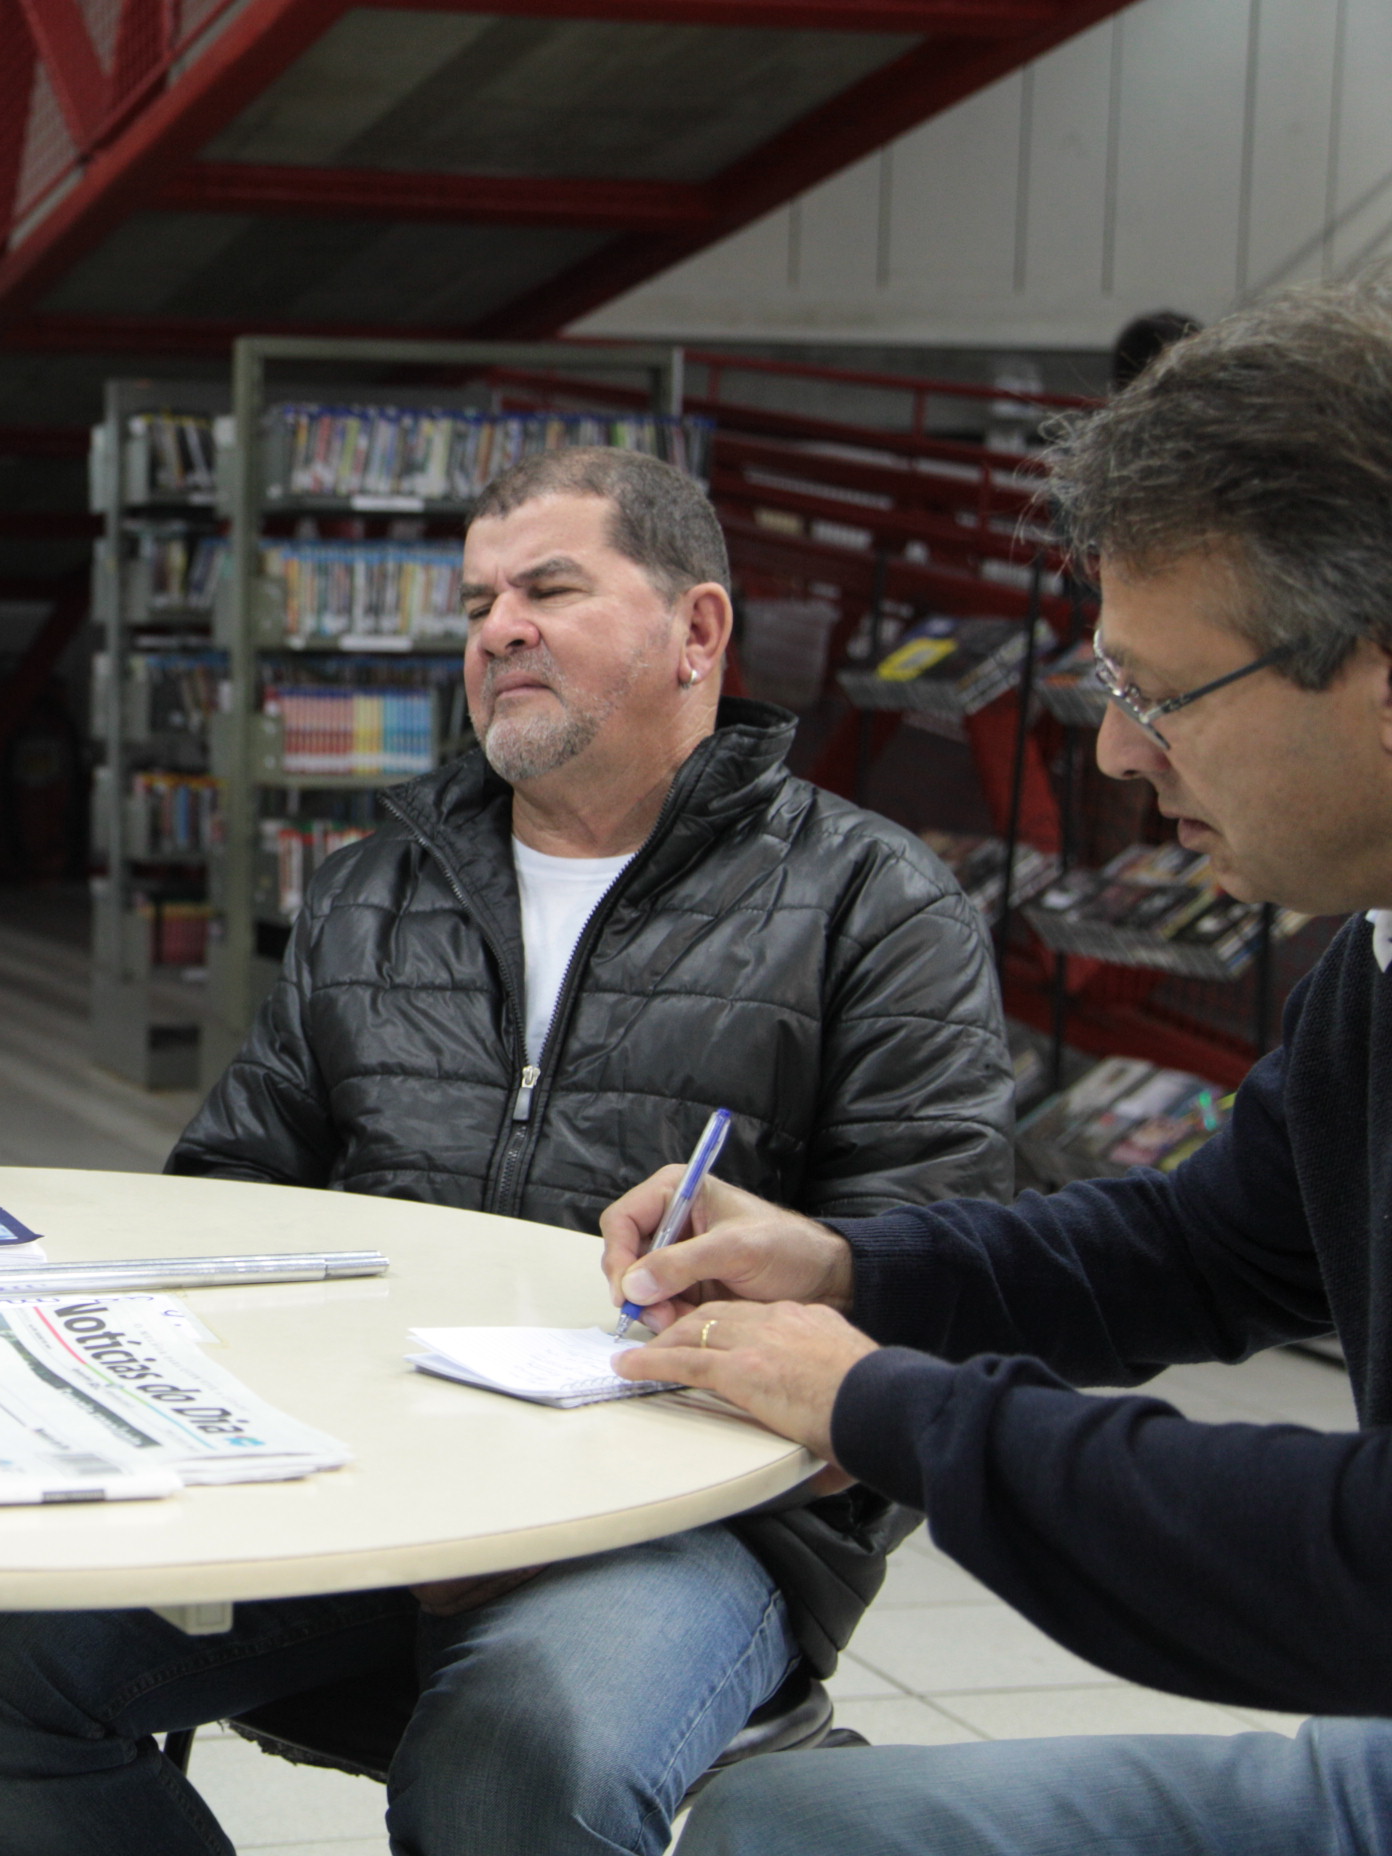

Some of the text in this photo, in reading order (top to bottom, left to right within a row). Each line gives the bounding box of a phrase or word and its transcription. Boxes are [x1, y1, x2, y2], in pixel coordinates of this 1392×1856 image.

[54, 1301, 163, 1380] Notícias
[136, 1383, 202, 1402] do
[170, 1407, 250, 1434] Dia
